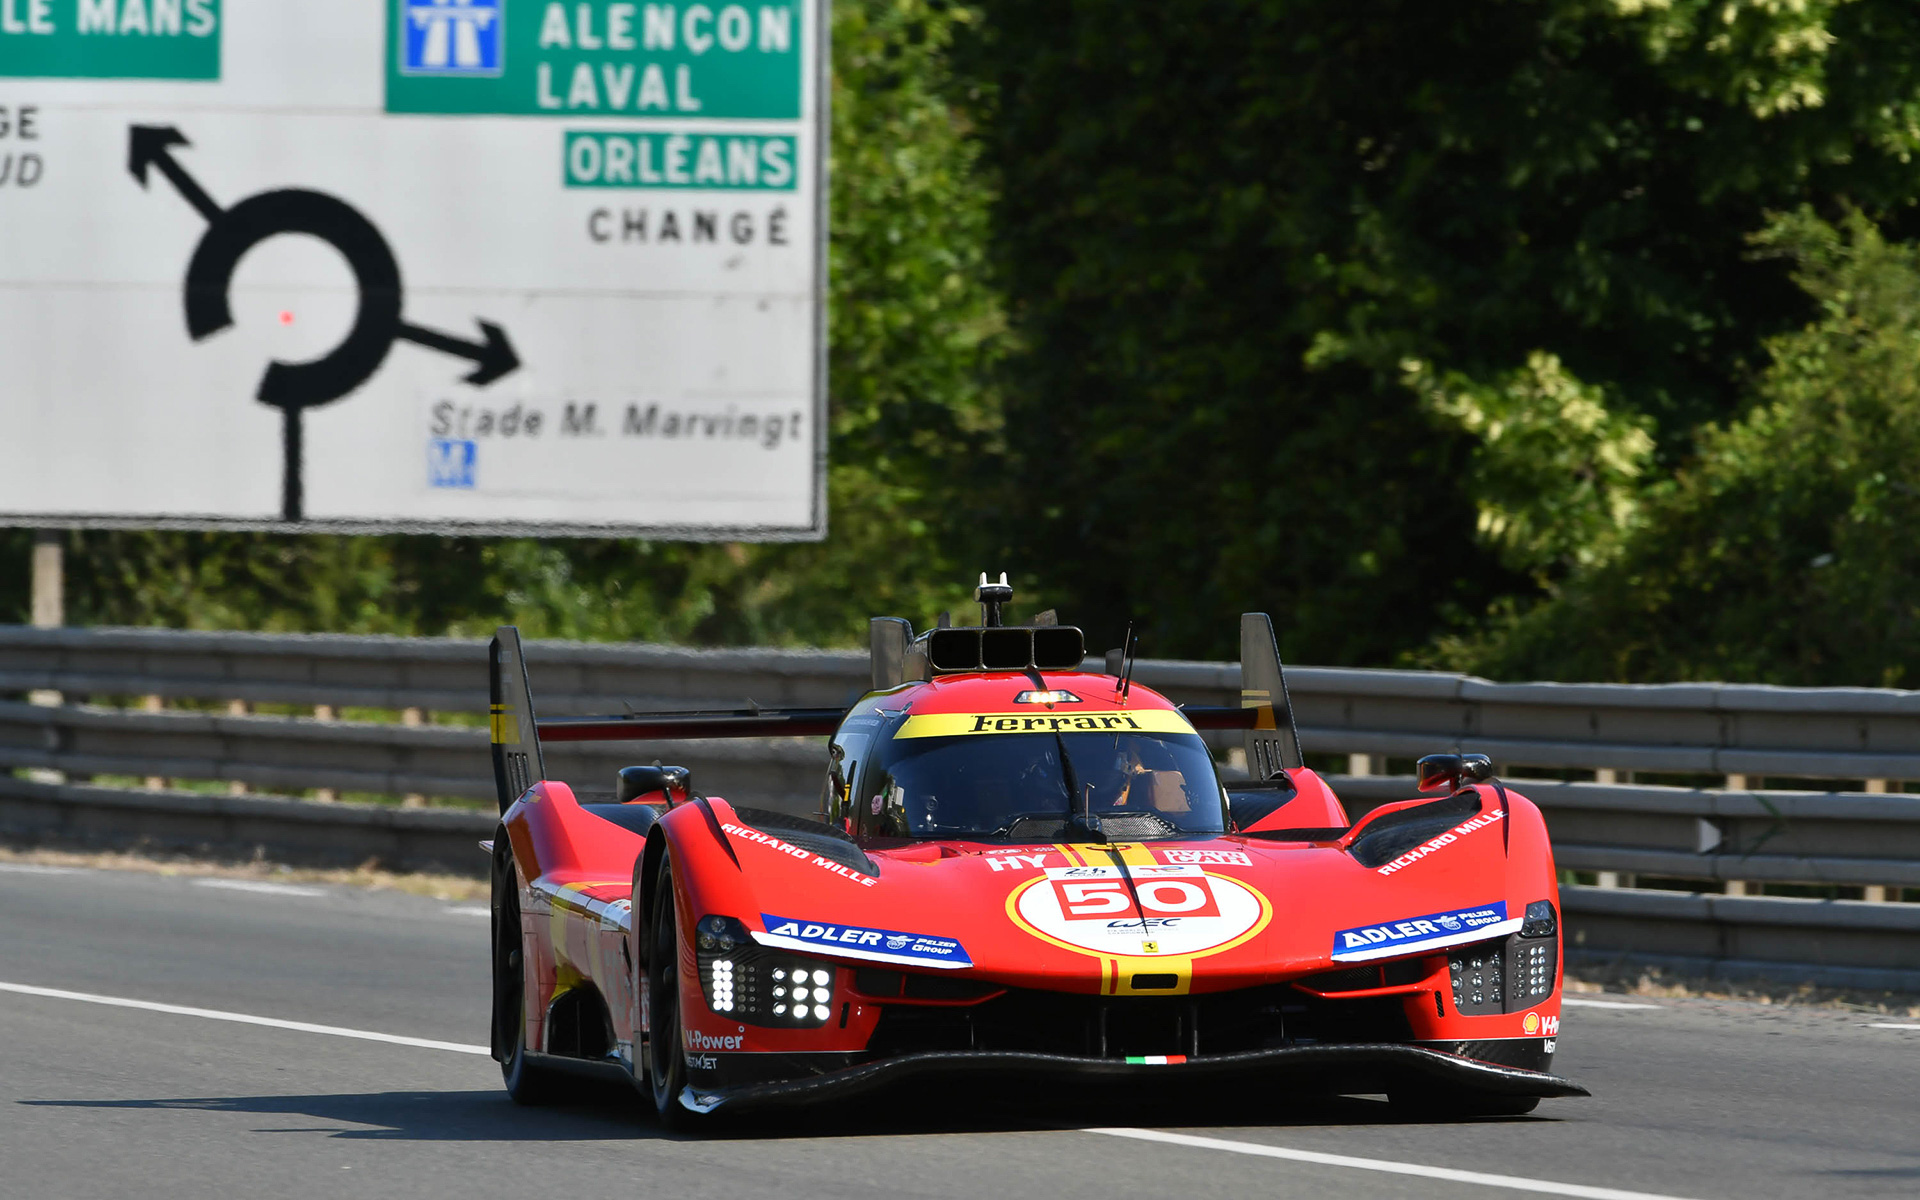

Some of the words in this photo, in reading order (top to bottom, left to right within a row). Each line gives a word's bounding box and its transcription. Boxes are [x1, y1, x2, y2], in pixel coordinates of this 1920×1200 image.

[2, 0, 54, 34] LE
[77, 0, 216, 37] MANS
[540, 3, 791, 54] ALENÇON
[538, 63, 701, 111] LAVAL
[569, 134, 793, 187] ORLÉANS
[587, 207, 789, 246] CHANGÉ
[430, 401, 542, 436] Stade
[622, 402, 802, 450] Marvingt
[968, 713, 1142, 733] Ferrari
[720, 823, 810, 859] RICHARD
[812, 857, 877, 887] MILLE
[1377, 833, 1457, 876] RICHARD
[1455, 809, 1508, 835] MILLE
[985, 854, 1046, 872] HY
[1062, 881, 1207, 915] 50
[1106, 918, 1182, 928] WEC
[1458, 909, 1496, 921] PELZER
[1468, 915, 1502, 927] GROUP
[770, 922, 882, 946] ADLER
[915, 937, 957, 948] PELZER
[1342, 919, 1440, 948] ADLER
[911, 944, 953, 955] GROUP
[686, 1029, 744, 1049] V-Power
